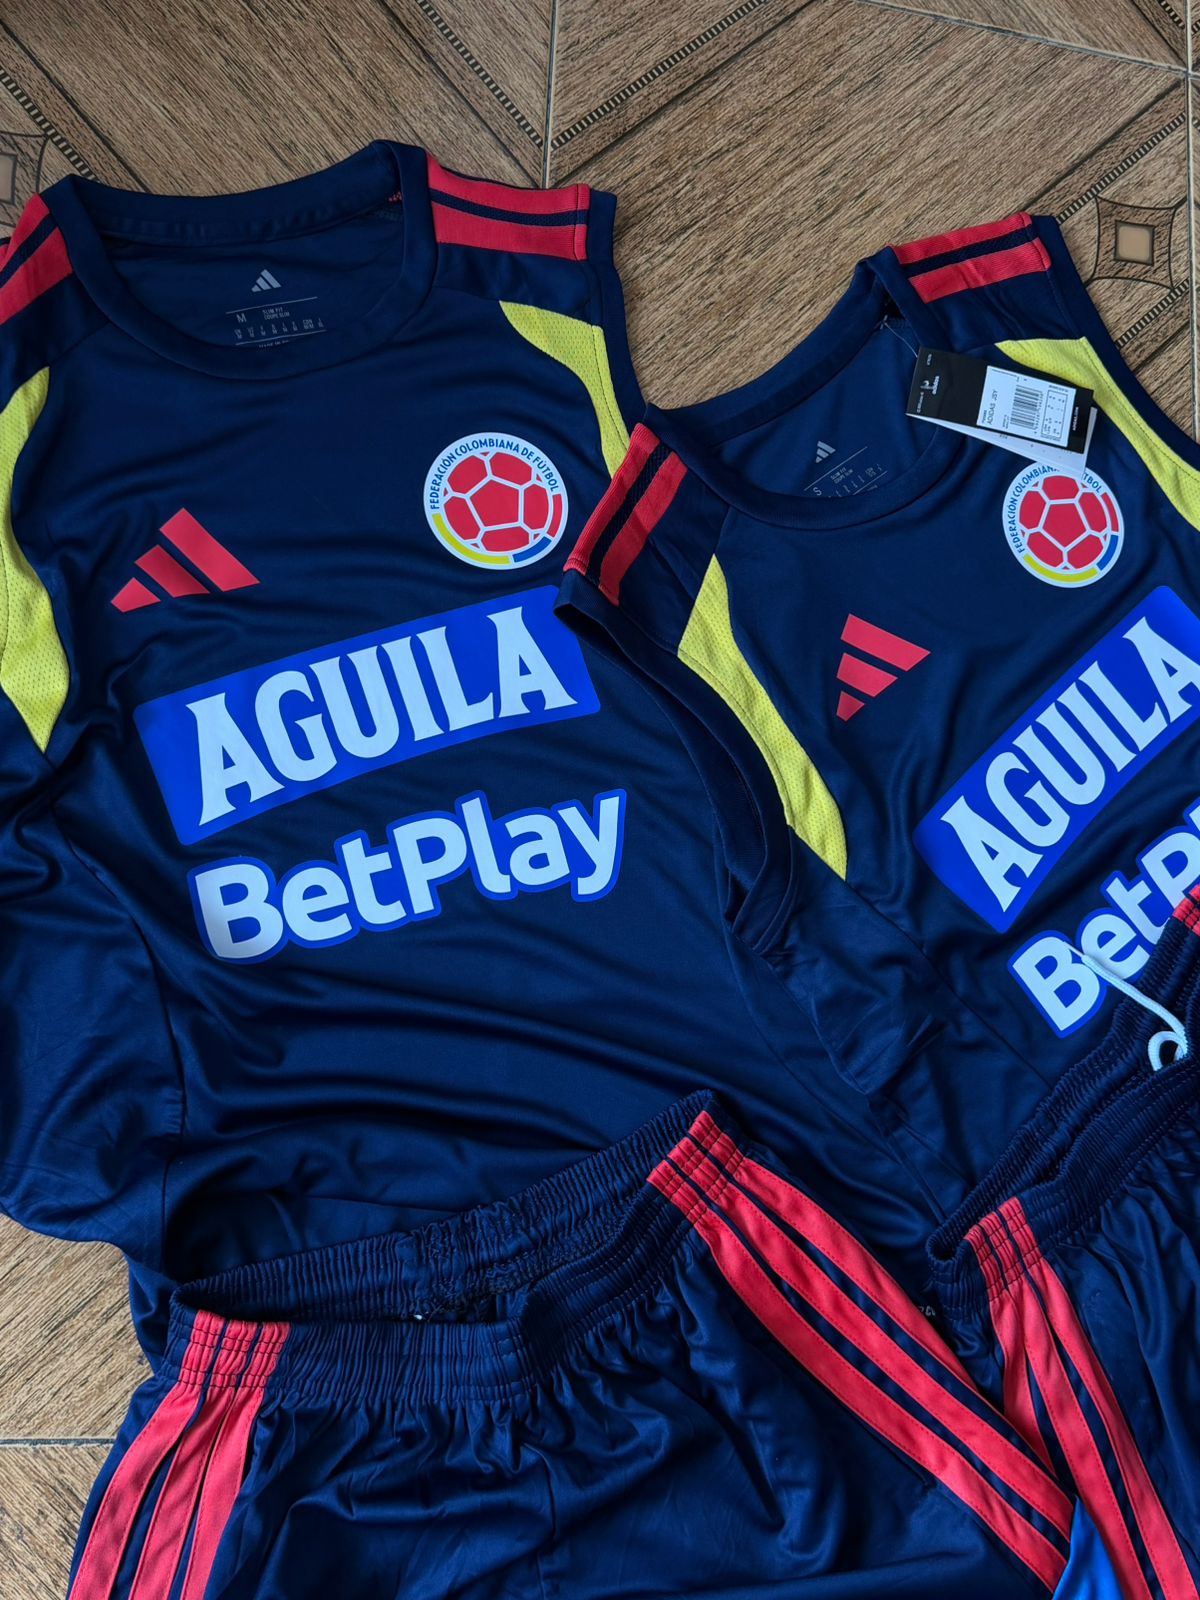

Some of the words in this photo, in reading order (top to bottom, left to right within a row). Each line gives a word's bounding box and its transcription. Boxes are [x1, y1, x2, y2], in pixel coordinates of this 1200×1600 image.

[236, 312, 247, 323] M
[932, 375, 940, 395] adidas
[987, 403, 996, 425] ADIDAS
[430, 453, 457, 510] FEDERACIÓN
[455, 438, 519, 457] COLOMBIANA
[521, 448, 534, 460] DE
[532, 456, 560, 492] FÚTBOL
[812, 487, 822, 496] S
[1007, 497, 1025, 554] FEDERACIÓN
[186, 606, 579, 827] AGUILA
[940, 616, 1200, 913] AGUILA
[194, 795, 623, 960] BetPlay
